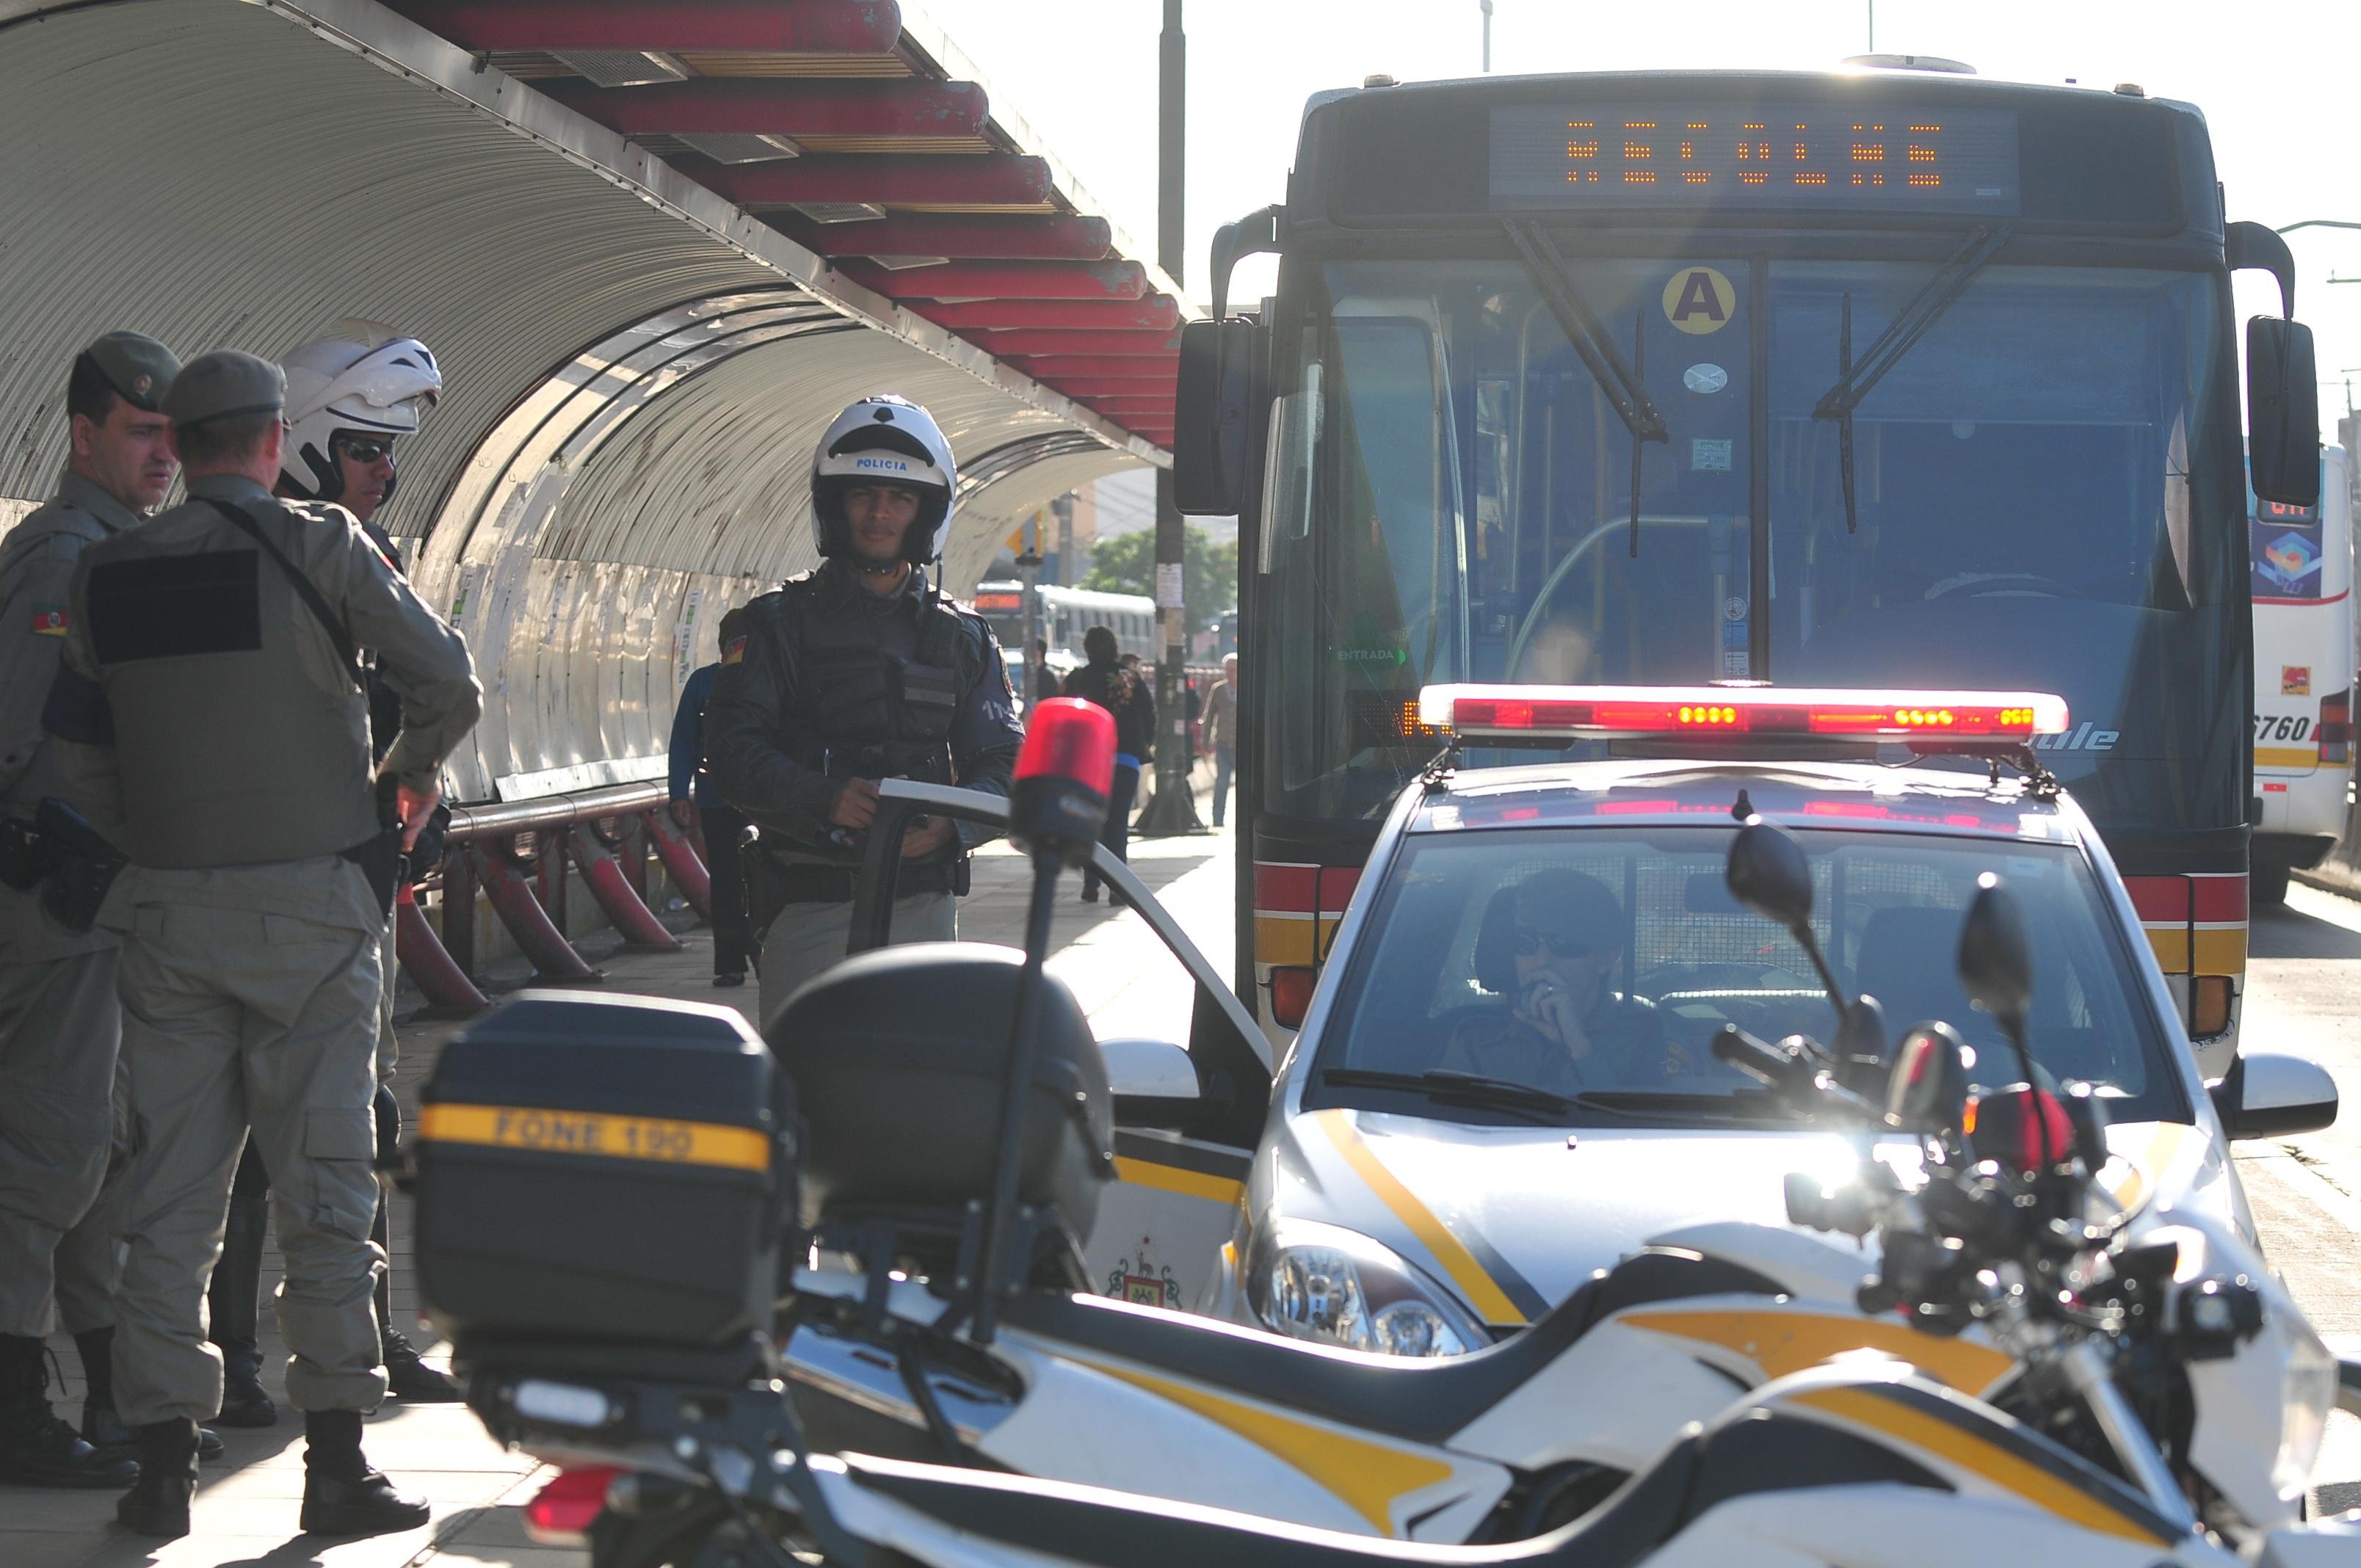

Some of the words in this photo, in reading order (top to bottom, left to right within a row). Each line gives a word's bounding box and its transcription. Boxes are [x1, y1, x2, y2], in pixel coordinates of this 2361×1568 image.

[1568, 122, 1940, 185] RECOLHE
[1672, 272, 1725, 321] A
[857, 458, 907, 471] POLICIA
[1338, 650, 1393, 661] ENTRADA
[496, 1109, 603, 1151] FONE
[623, 1123, 694, 1157] 190
